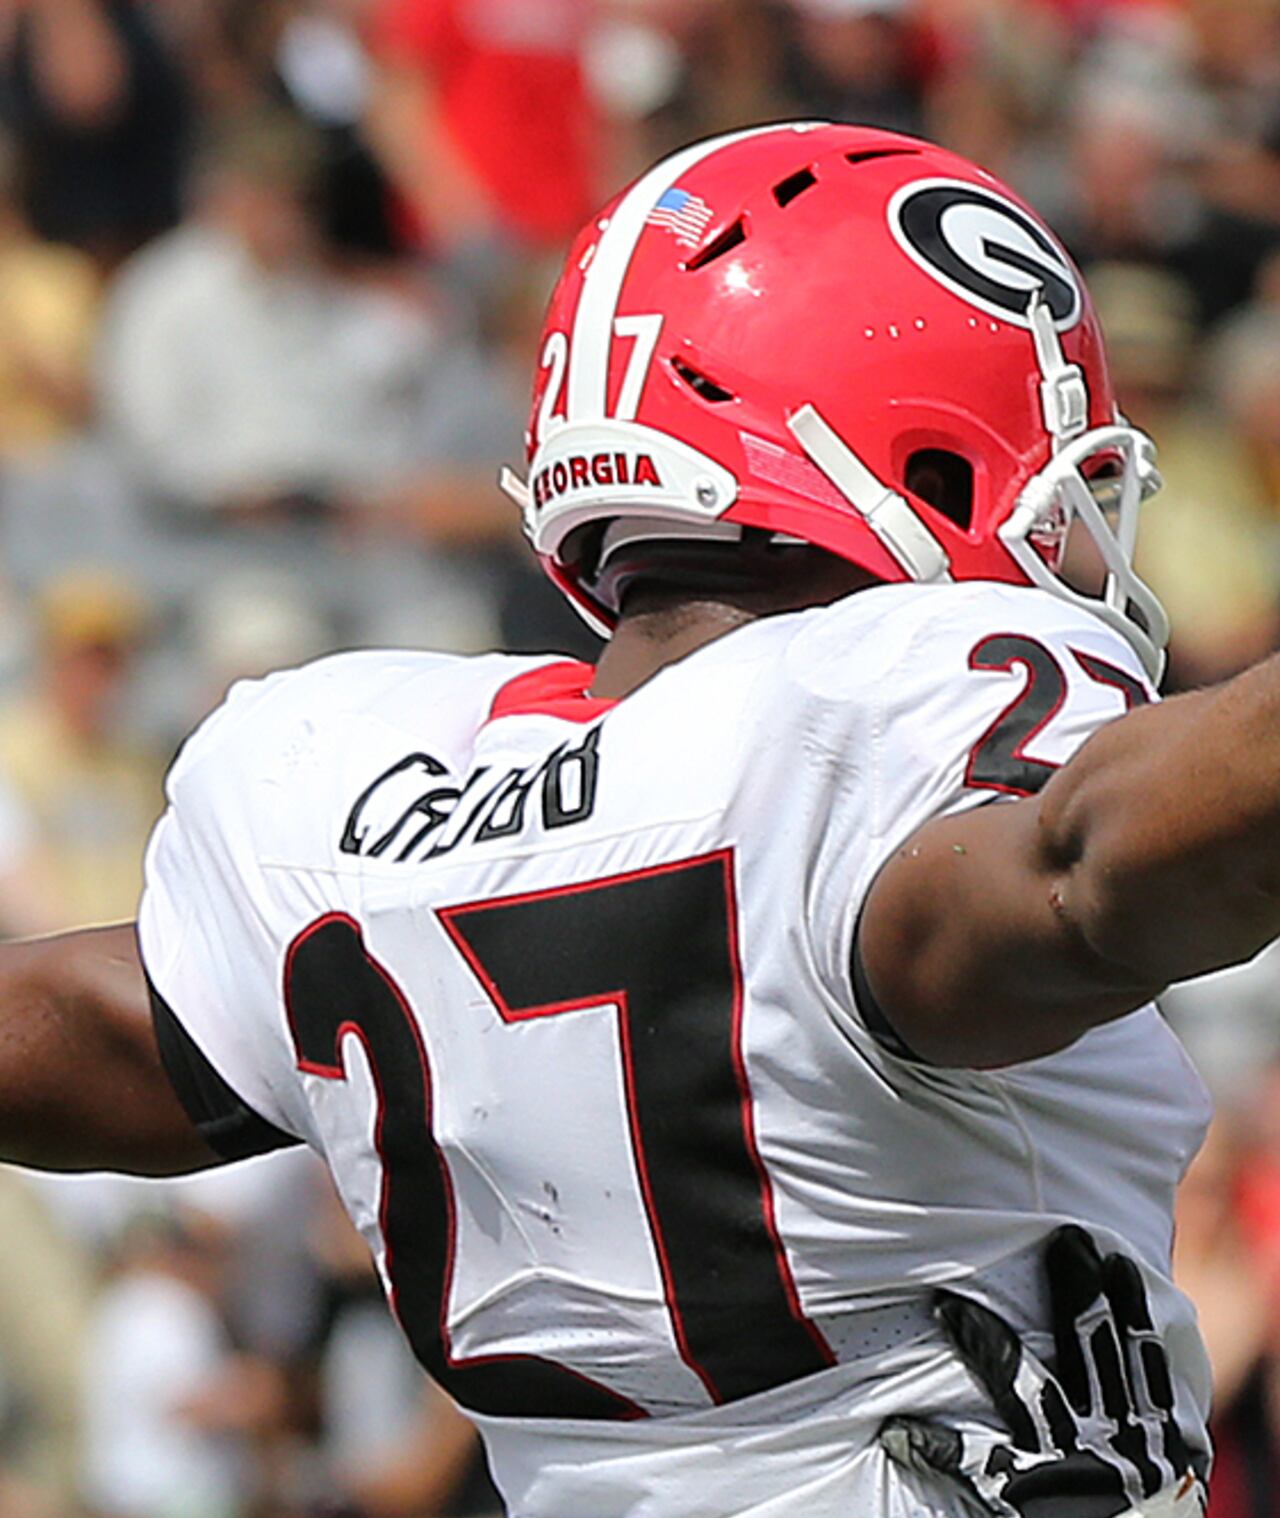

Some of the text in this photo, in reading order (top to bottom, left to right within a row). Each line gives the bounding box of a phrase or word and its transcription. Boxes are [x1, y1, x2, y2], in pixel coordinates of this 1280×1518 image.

[888, 178, 1082, 333] G
[537, 313, 664, 441] 27
[283, 848, 838, 1421] 27
